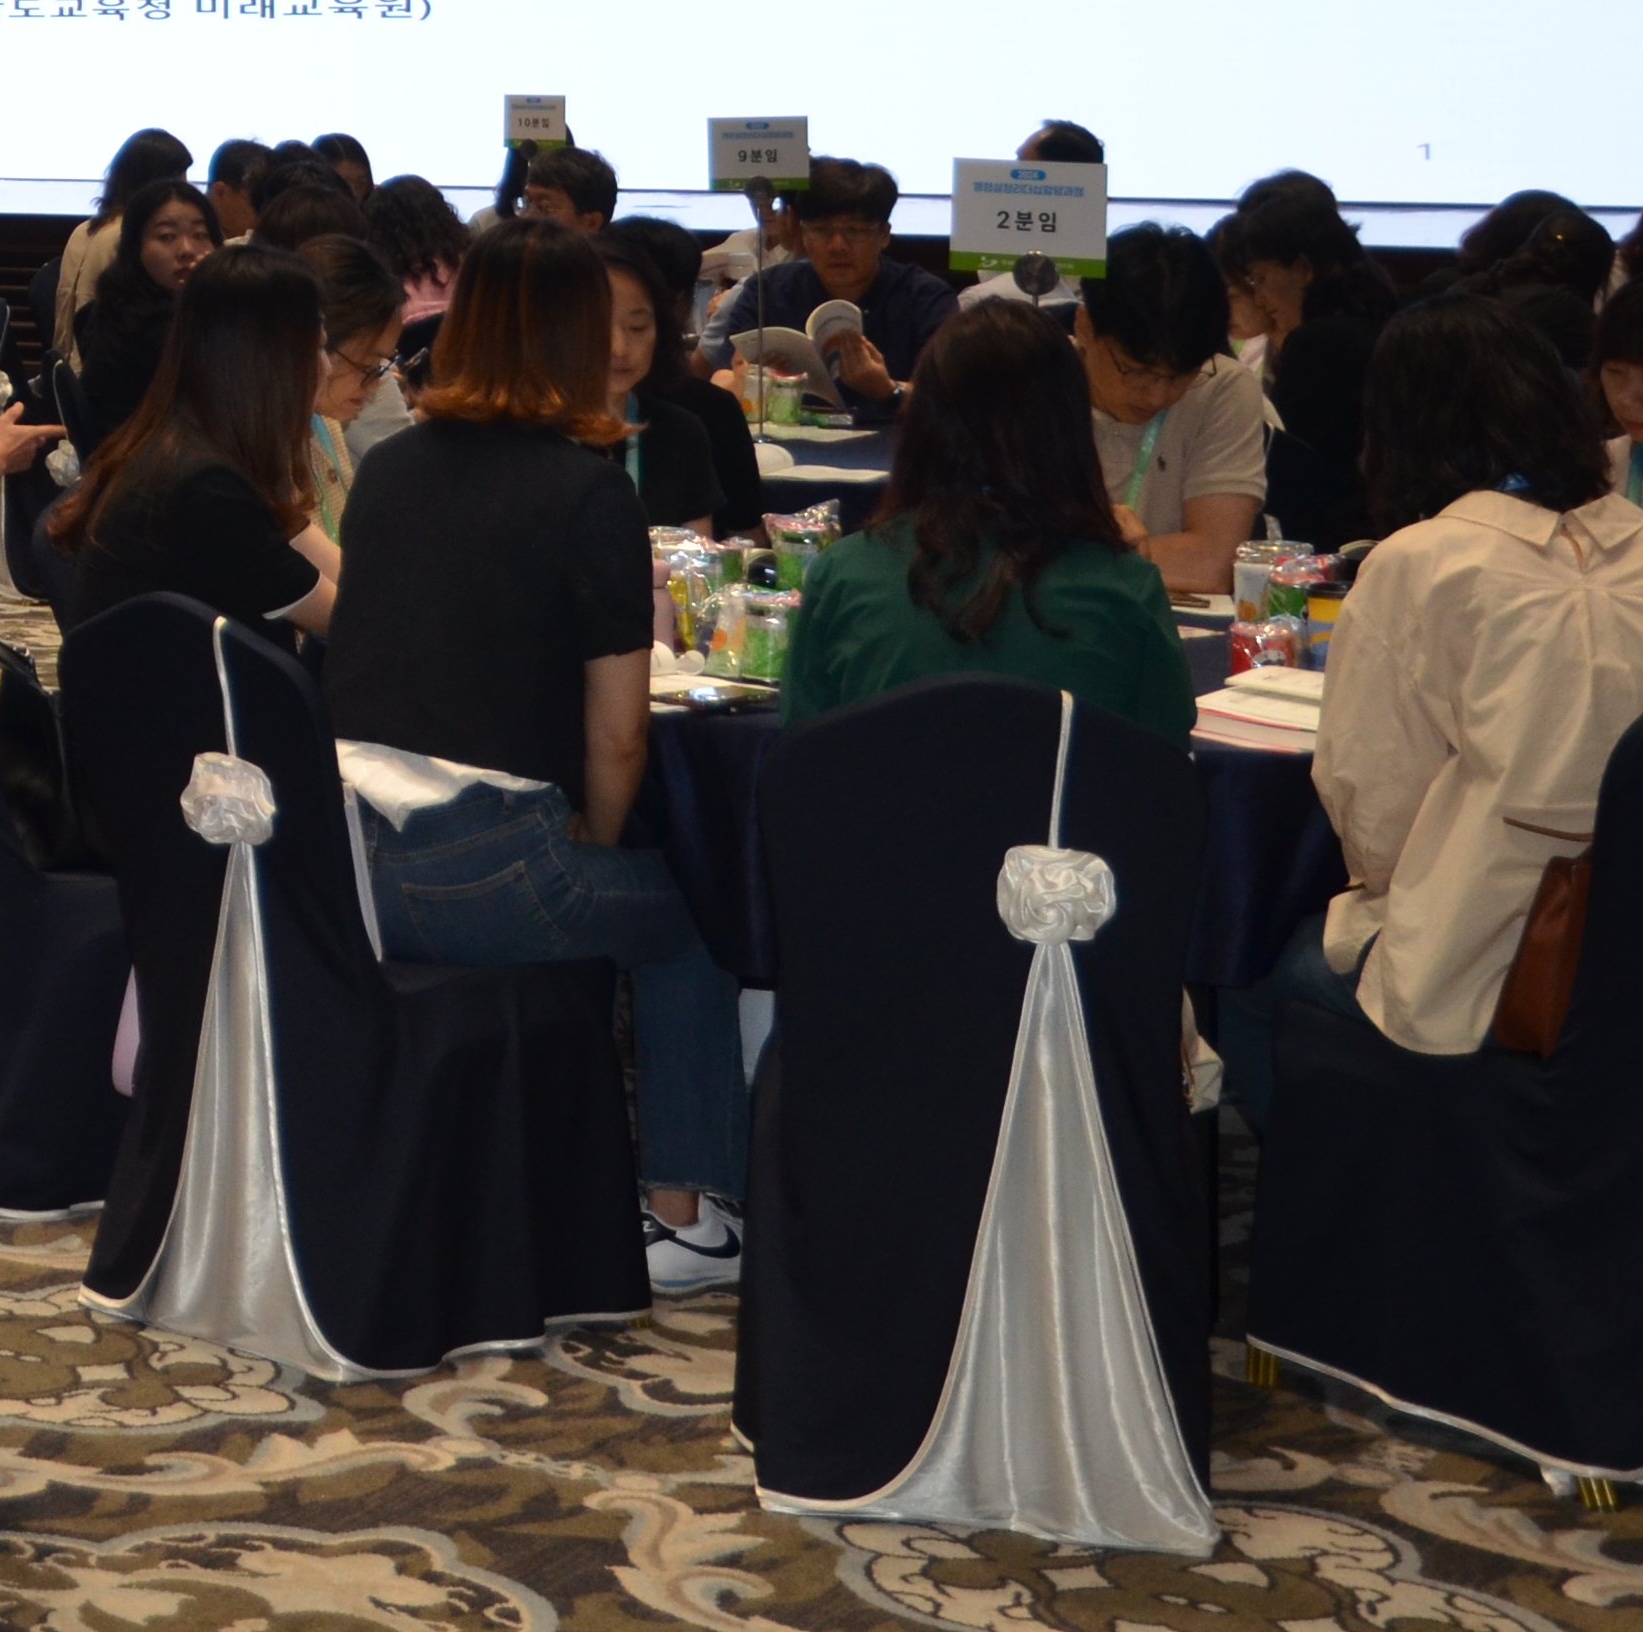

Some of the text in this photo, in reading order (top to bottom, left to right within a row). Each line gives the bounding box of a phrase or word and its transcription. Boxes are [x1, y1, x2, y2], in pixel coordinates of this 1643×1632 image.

[518, 118, 550, 128] 10분임
[737, 148, 778, 163] 9분임
[1417, 142, 1430, 160] 1
[996, 210, 1058, 234] 2분임
